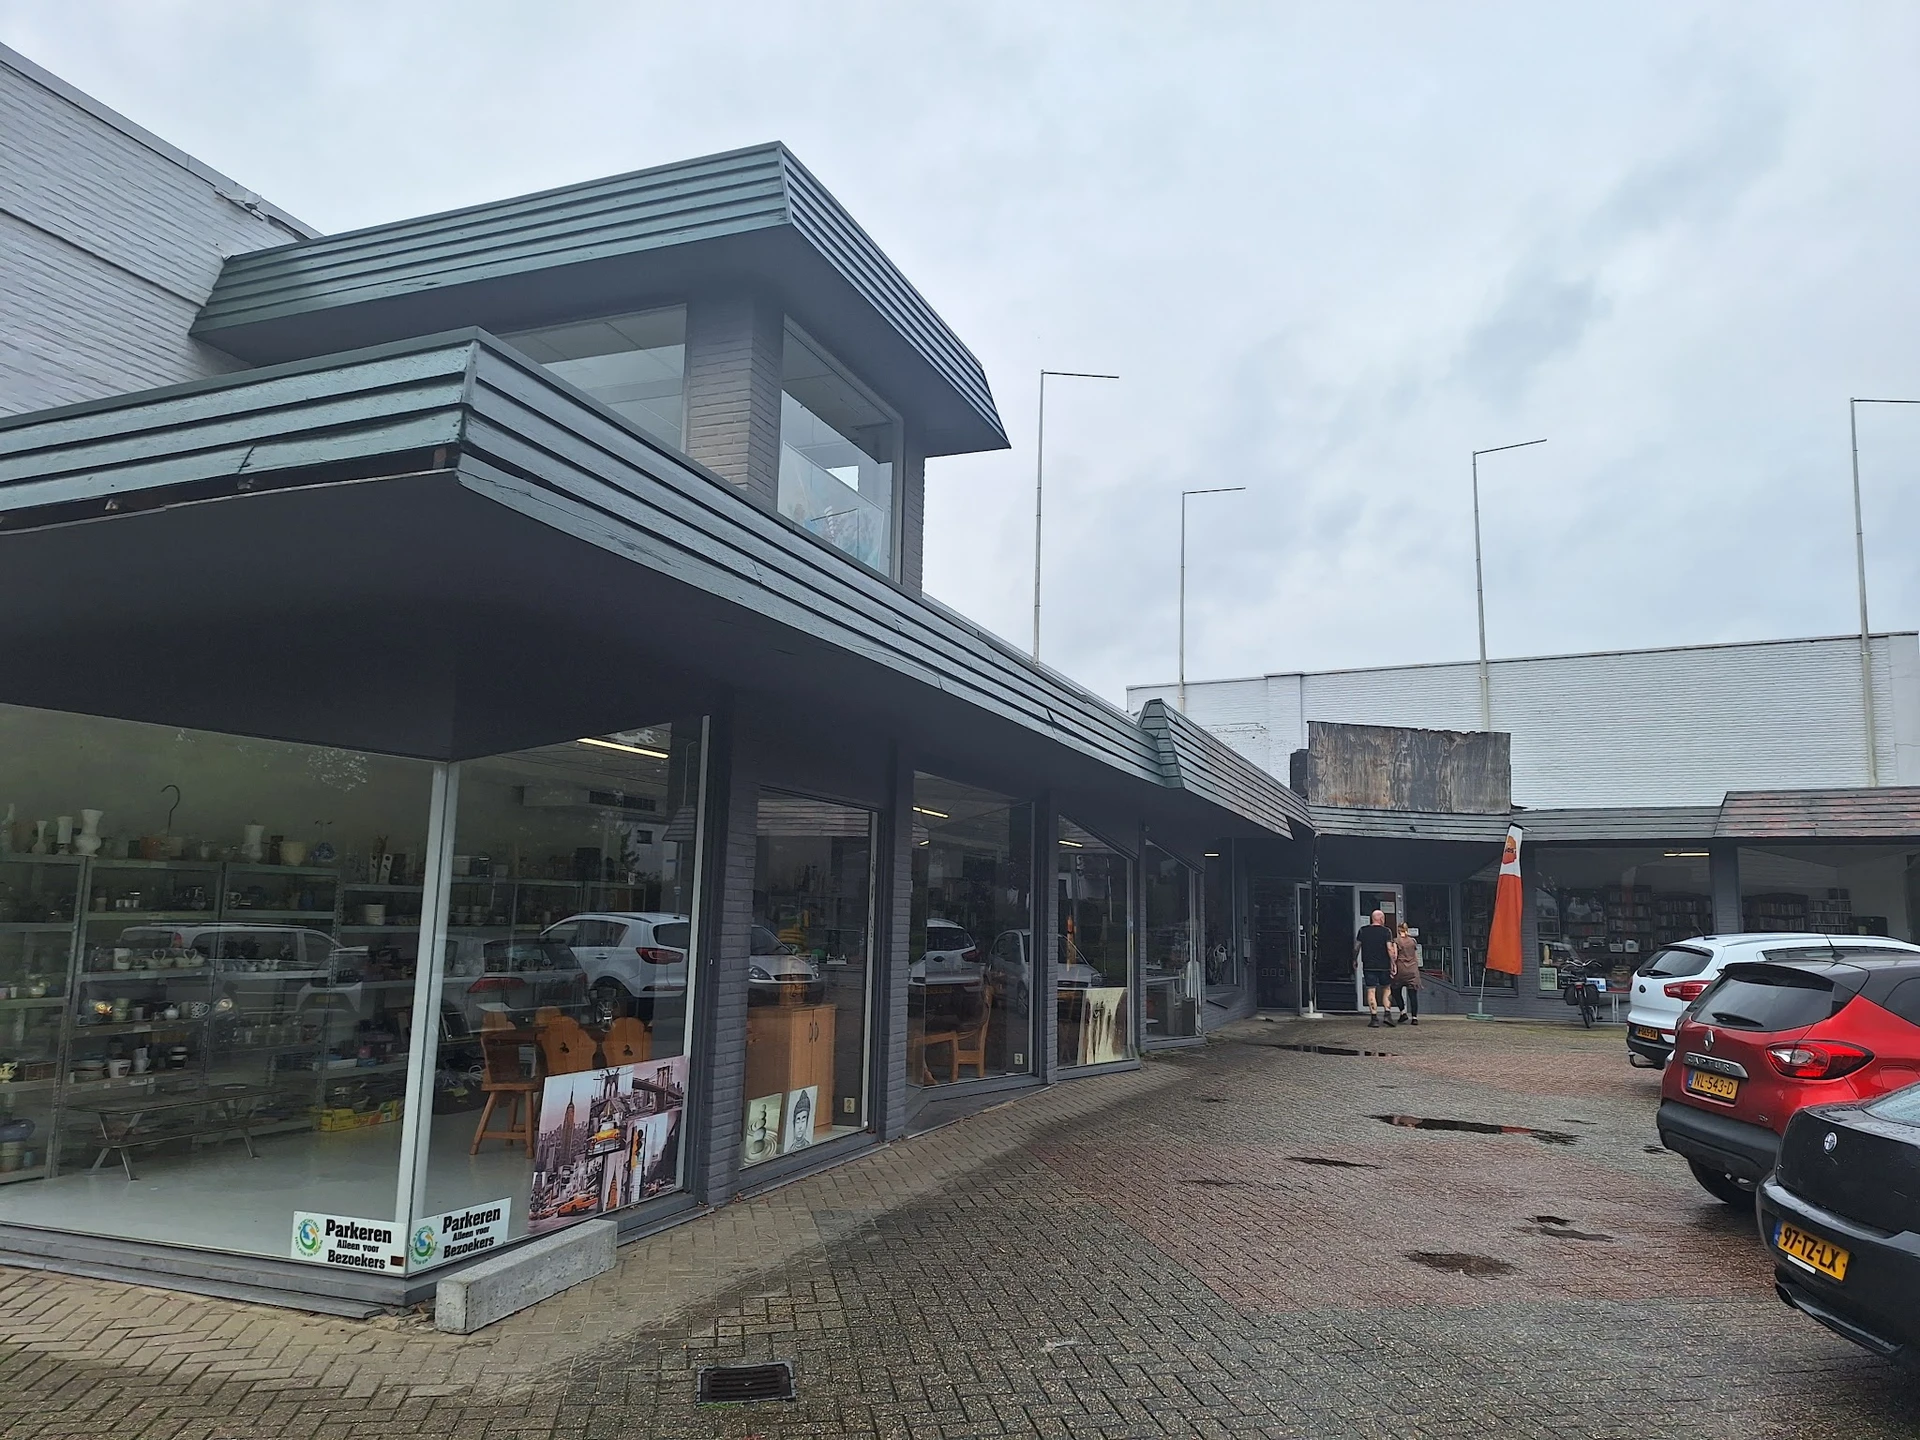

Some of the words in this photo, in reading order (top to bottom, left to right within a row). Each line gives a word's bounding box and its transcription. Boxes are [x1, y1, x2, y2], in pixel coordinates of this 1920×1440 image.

[1688, 1055, 1730, 1072] CAPTUR
[1694, 1072, 1734, 1095] NL-543-D
[325, 1218, 392, 1244] Parkeren
[442, 1207, 501, 1234] Parkeren
[452, 1230, 474, 1242] Alleen
[475, 1226, 490, 1236] voor
[337, 1239, 360, 1251] Alleen
[362, 1244, 379, 1253] voor
[443, 1236, 495, 1259] Bezoekers
[1783, 1226, 1840, 1273] 97-TZ-LX
[327, 1249, 386, 1270] Bezoekers
